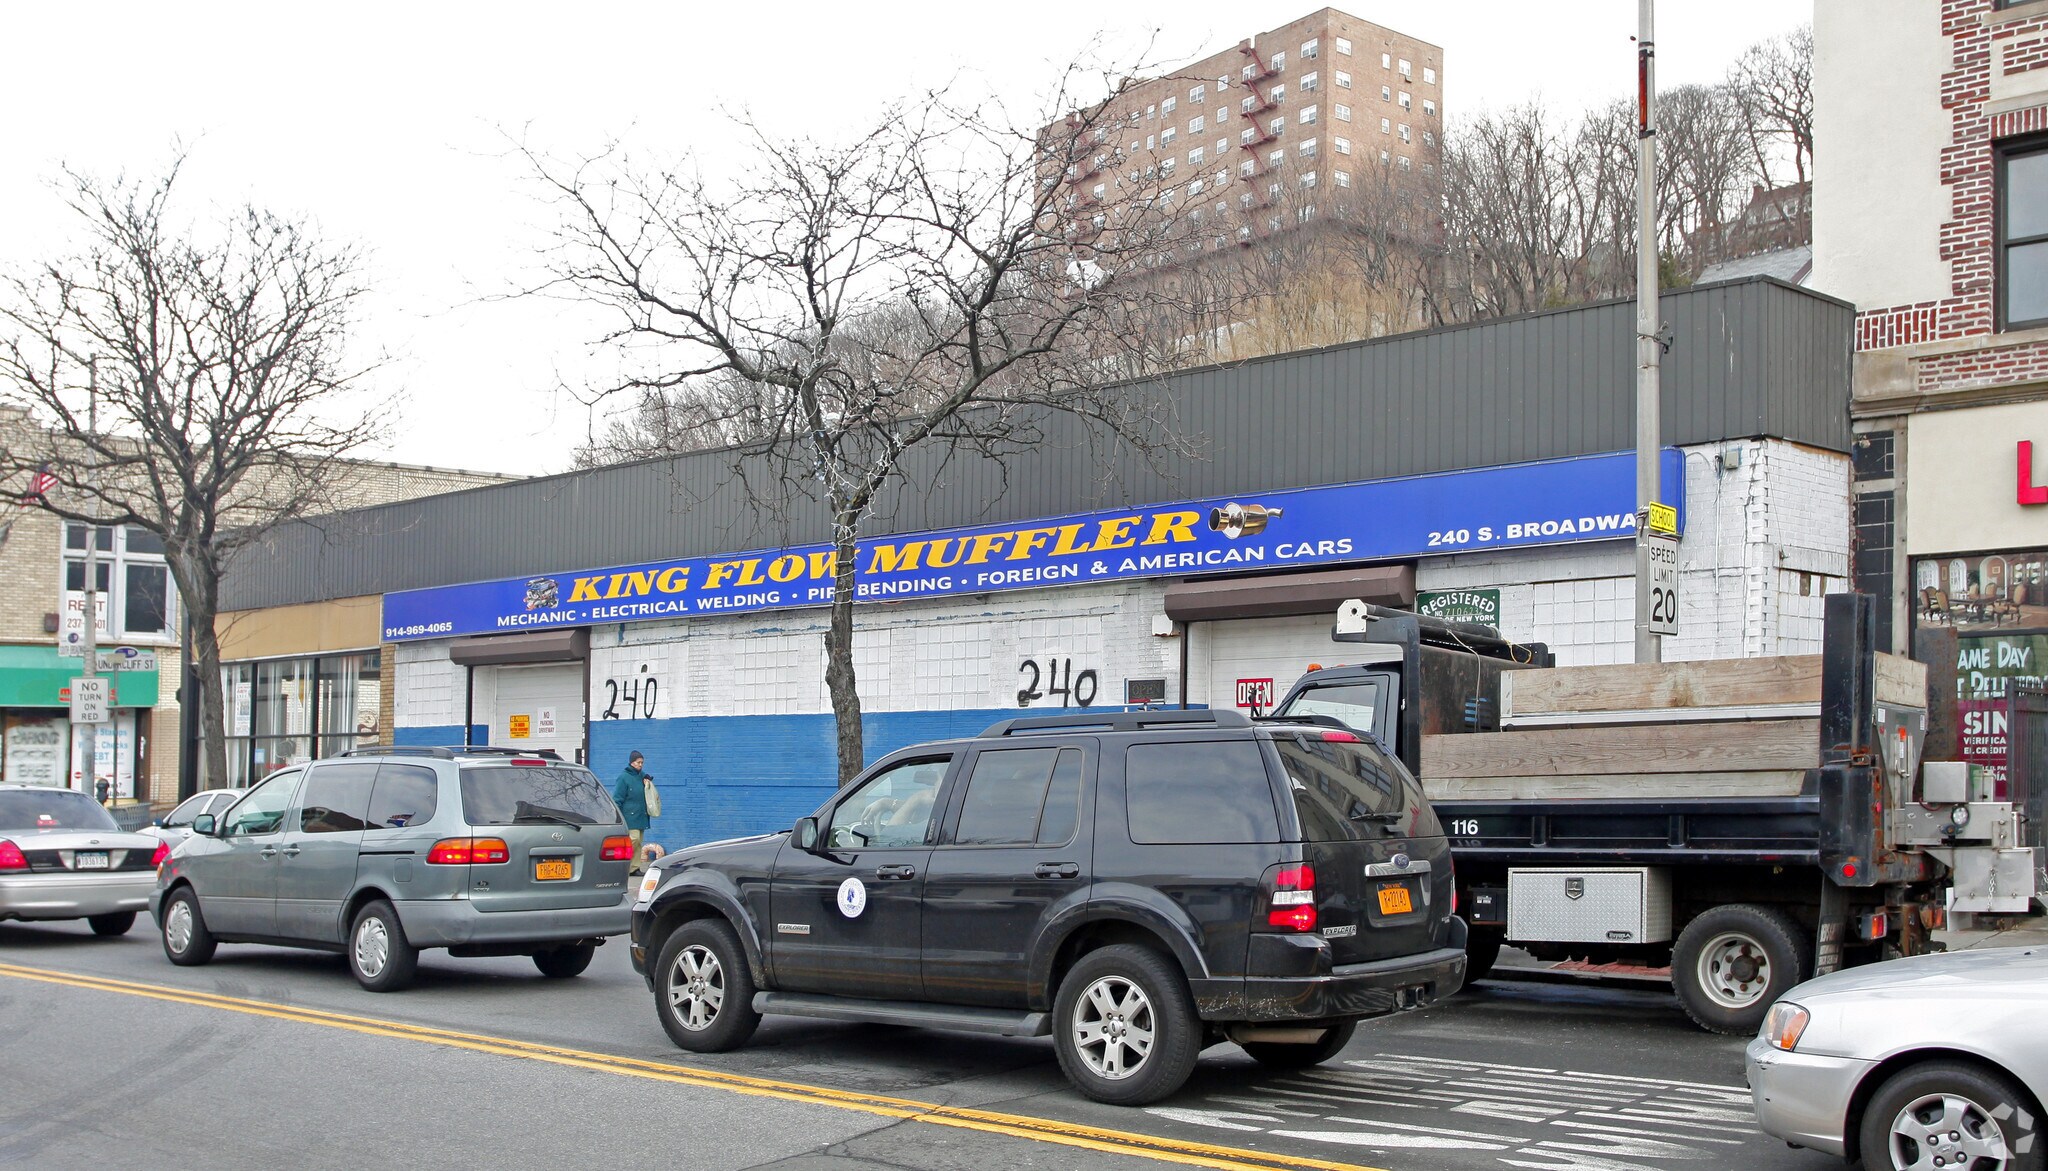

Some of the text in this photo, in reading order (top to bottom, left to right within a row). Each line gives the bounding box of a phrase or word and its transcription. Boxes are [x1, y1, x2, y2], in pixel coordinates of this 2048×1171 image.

[1651, 508, 1675, 528] SCHOOL
[1428, 513, 1637, 546] 240 S. BROADWA
[567, 566, 690, 603] KING
[865, 511, 1200, 574] MUFFLER
[1651, 546, 1675, 564] SPEED
[1654, 567, 1673, 583] LIMIT
[386, 622, 452, 638] 914-969-4065
[497, 610, 576, 627] MECHANIC
[592, 600, 688, 618] ELECTRICAL
[697, 591, 780, 610] WELDING
[857, 576, 951, 596] BENDING
[977, 563, 1078, 586] FOREIGN
[1091, 561, 1108, 575] &
[1118, 546, 1264, 573] AMERICAN
[1275, 538, 1353, 559] CARS
[68, 600, 105, 611] RET
[1421, 593, 1495, 616] REGISTERED
[1652, 587, 1675, 624] 20
[144, 660, 153, 669] ST
[1957, 648, 1991, 670] AME
[81, 682, 99, 691] NO
[1017, 658, 1098, 708] 240
[1238, 681, 1271, 704] OPEN
[79, 693, 102, 701] TURN
[602, 677, 658, 720] 240
[81, 712, 98, 720] RED
[543, 711, 550, 719] NO
[1963, 711, 2008, 735] SIN
[1963, 737, 2006, 745] VERIFICA
[1451, 819, 1479, 835] 116
[1325, 926, 1356, 935] EXPLORER
